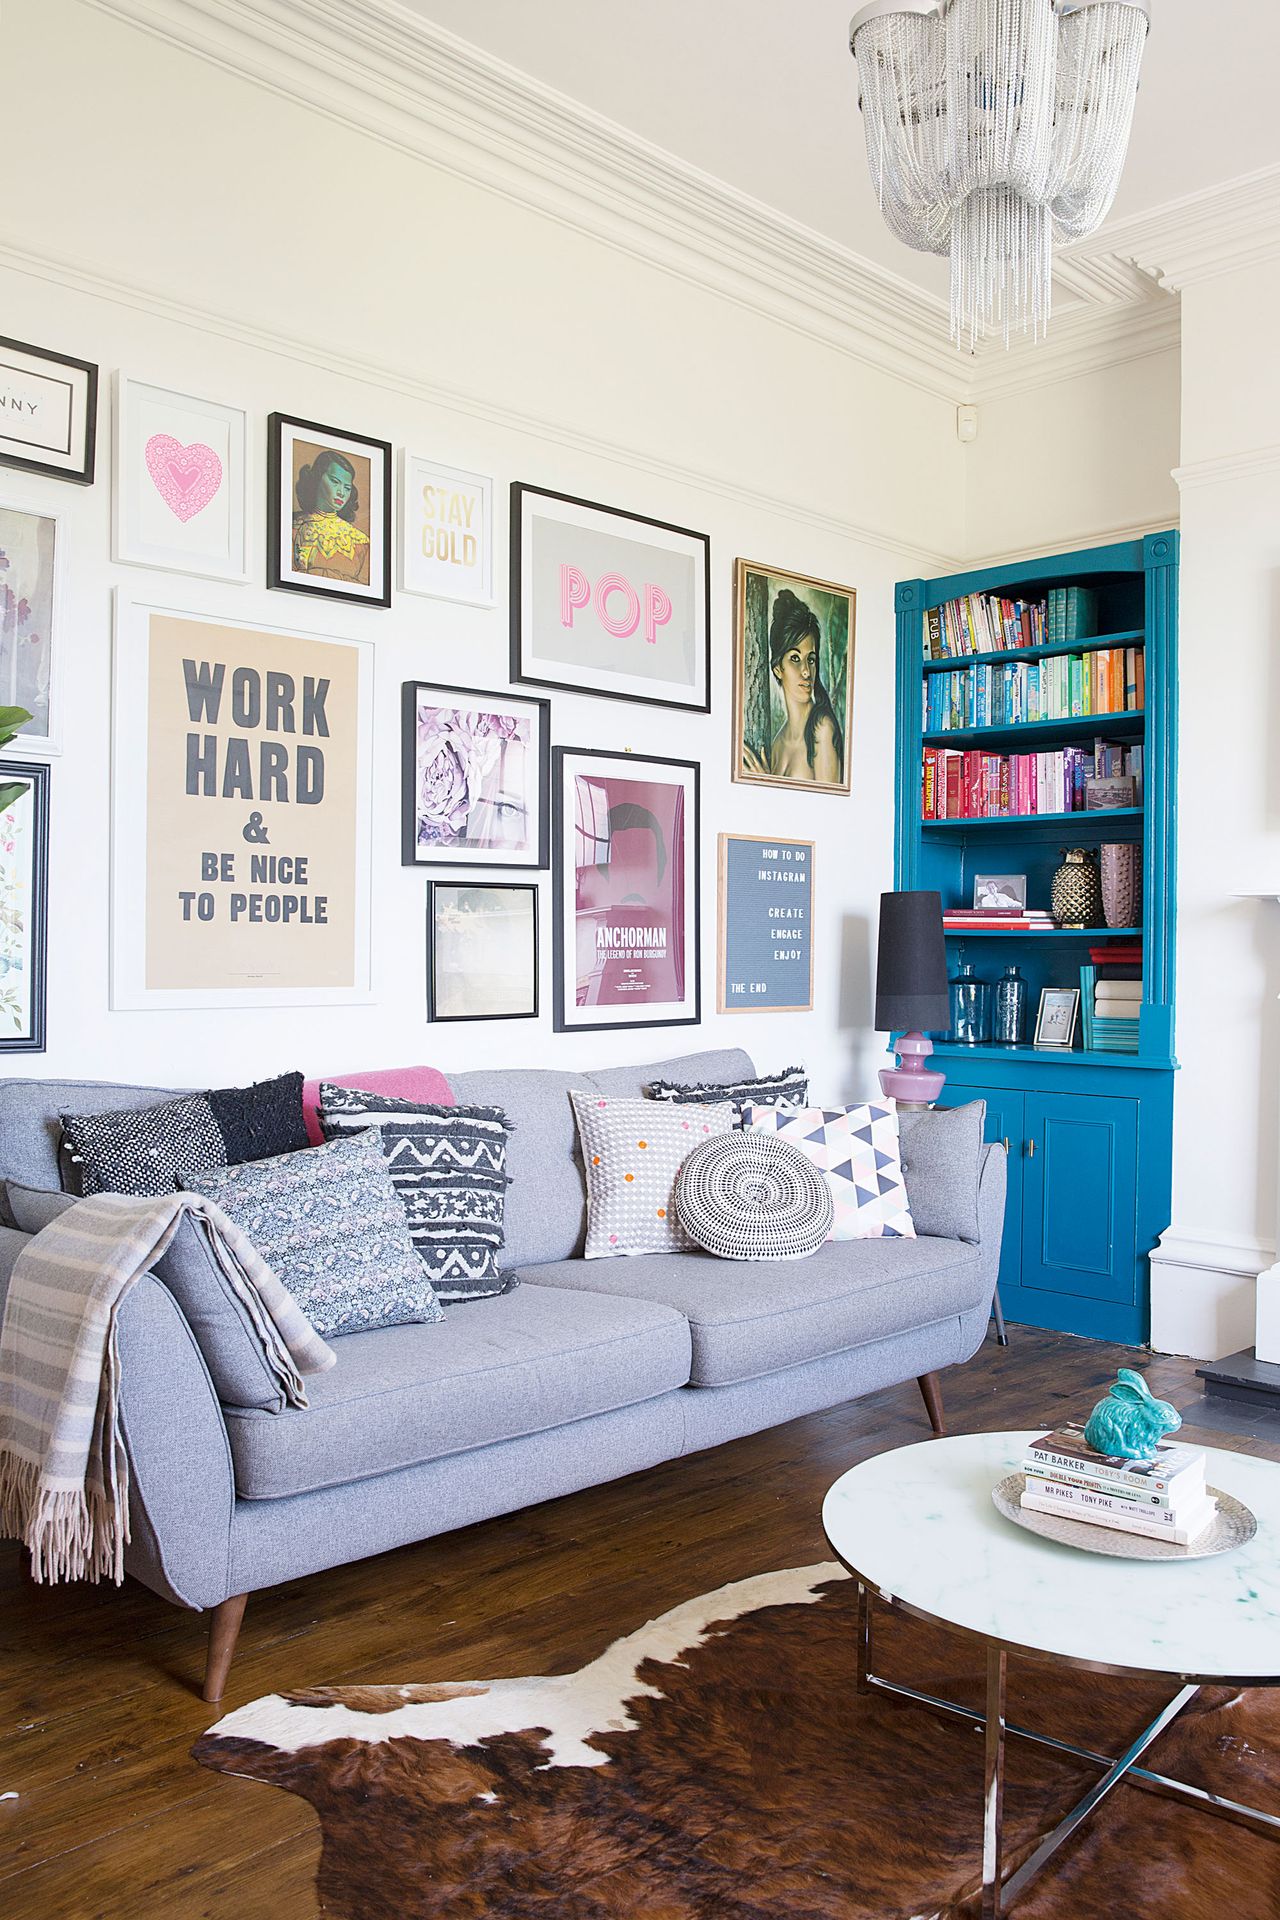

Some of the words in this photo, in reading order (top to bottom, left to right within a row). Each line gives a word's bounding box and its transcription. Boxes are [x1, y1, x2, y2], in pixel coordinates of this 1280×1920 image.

[423, 485, 476, 528] STAY
[422, 524, 477, 567] GOLD
[559, 563, 673, 644] POP
[929, 618, 940, 640] PUB
[182, 658, 330, 738] WORK
[186, 732, 324, 805] HARD
[242, 811, 270, 844] &
[762, 849, 778, 860] HOW
[782, 850, 791, 860] TO
[795, 851, 805, 861] DO
[201, 852, 235, 882] BE
[251, 854, 308, 885] NICE
[758, 870, 806, 882] INSTAGRAM
[178, 891, 214, 921] TO
[230, 893, 328, 924] PEOPLE
[768, 908, 804, 919] CREATE
[596, 926, 667, 948] ANCHORMAN
[771, 929, 802, 940] ENGAGE
[597, 949, 606, 959] THE
[607, 949, 625, 959] LEGEND
[626, 949, 633, 959] OF
[774, 950, 801, 960] ENJOY
[731, 983, 746, 993] THE
[750, 983, 767, 993] END
[1034, 1450, 1049, 1463] PAT
[1051, 1454, 1085, 1471] BARKER
[1095, 1466, 1121, 1480] TOBY'S
[1124, 1473, 1148, 1486] ROOM
[1067, 1476, 1083, 1485] YOUR
[1045, 1485, 1055, 1494] MR
[1056, 1487, 1074, 1499] PIKES
[1081, 1494, 1097, 1504] TONY
[1098, 1497, 1113, 1509] PIKE
